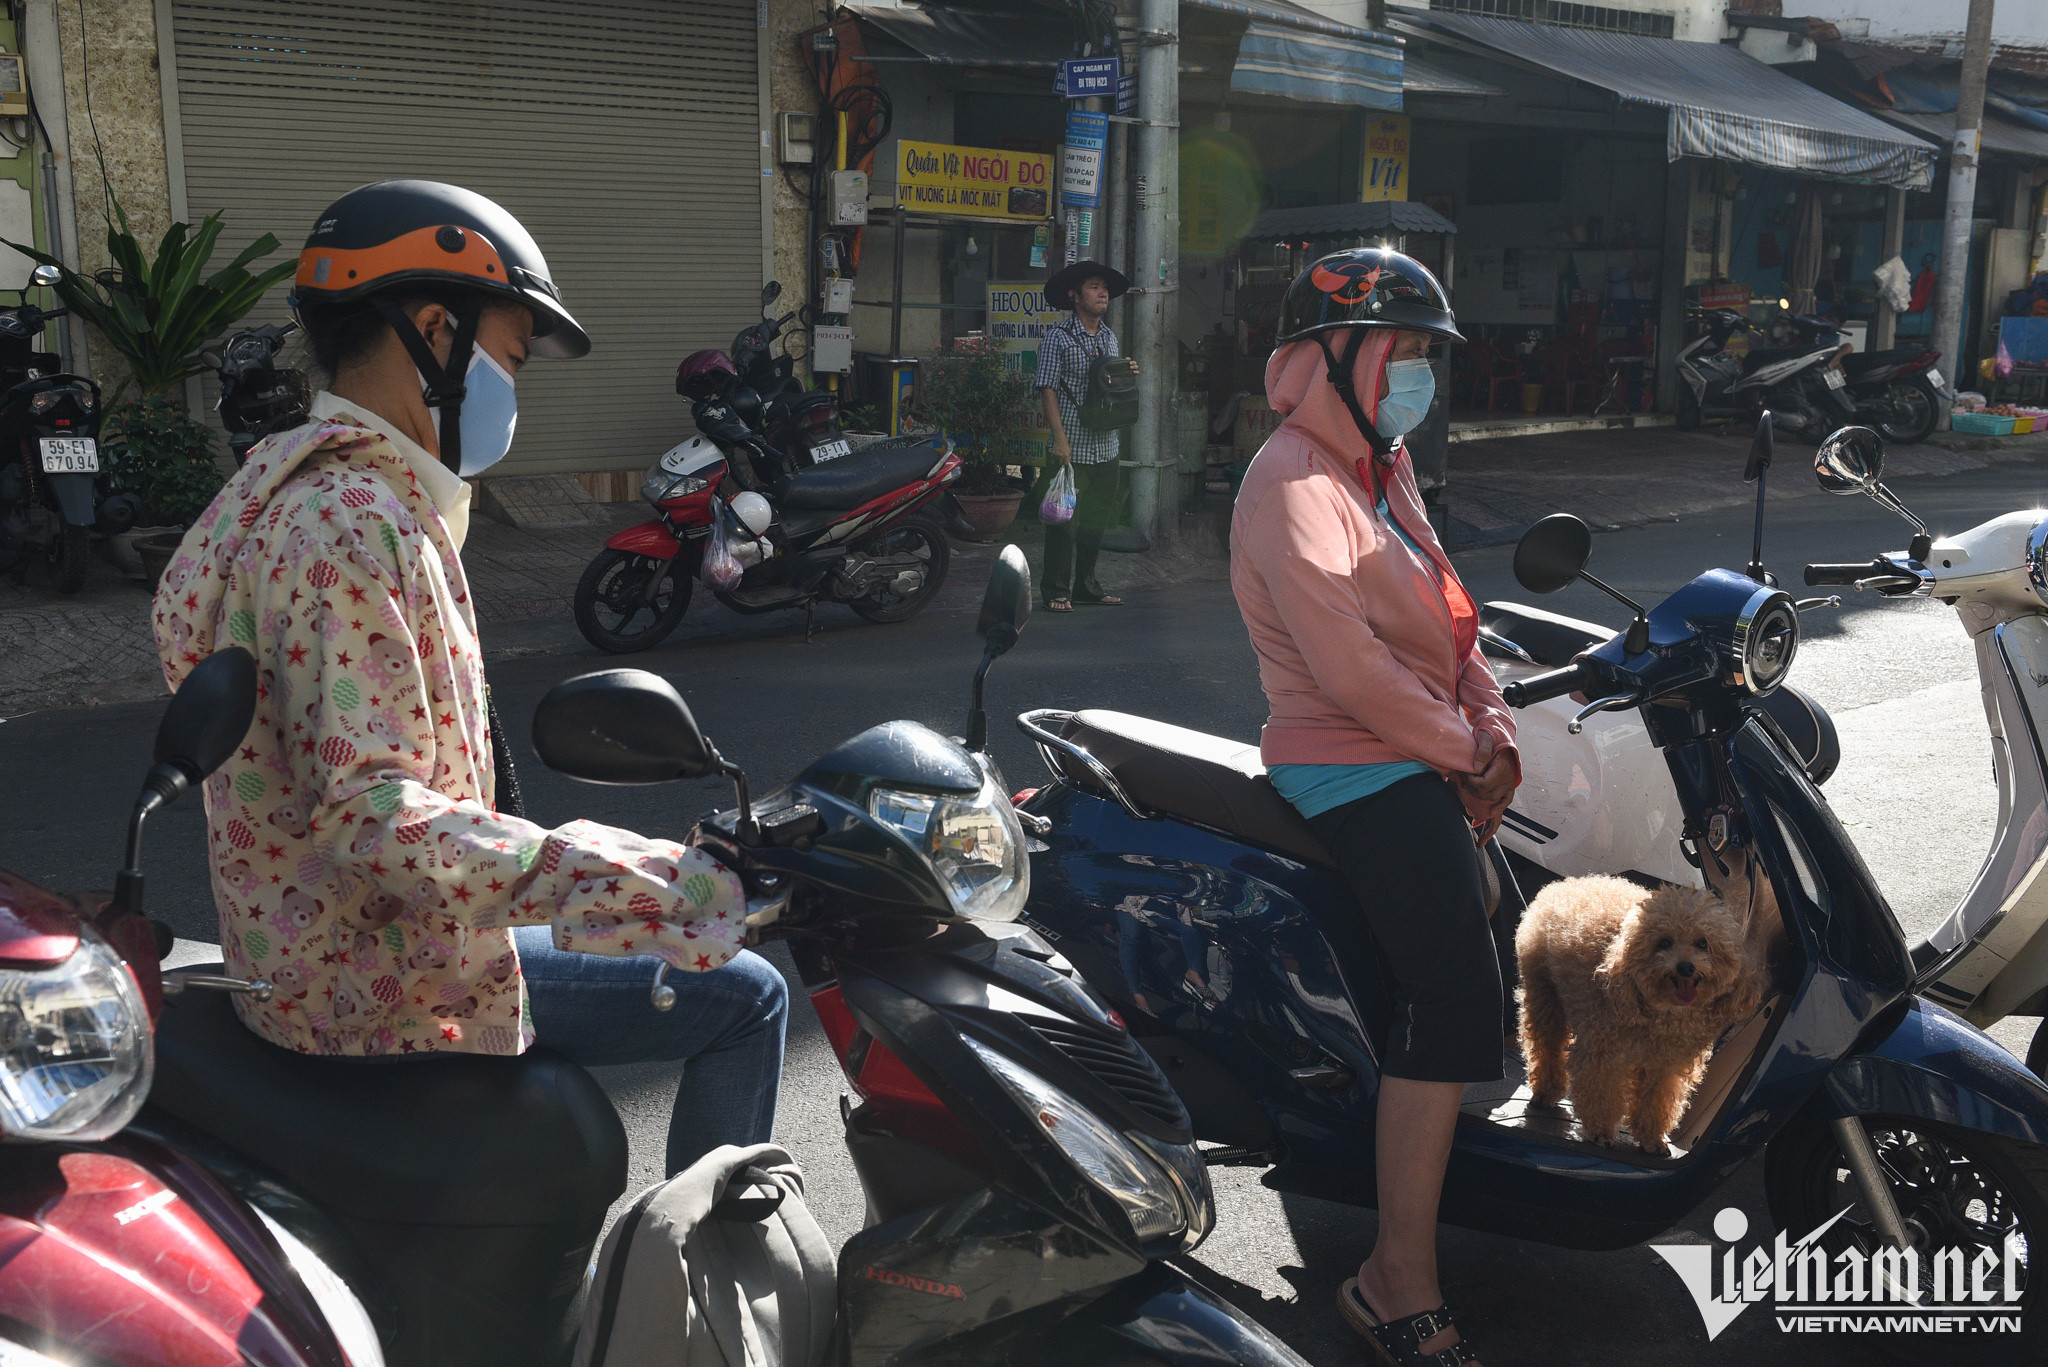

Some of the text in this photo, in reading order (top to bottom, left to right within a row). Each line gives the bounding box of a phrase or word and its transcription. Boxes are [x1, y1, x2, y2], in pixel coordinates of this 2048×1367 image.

[1097, 76, 1108, 87] H23
[906, 149, 939, 178] Quán
[963, 153, 1010, 184] NGÓI
[1081, 169, 1095, 177] CAO
[1370, 157, 1402, 197] Vịt
[991, 291, 1061, 317] HEO QU
[1017, 320, 1027, 339] LÁ
[48, 440, 87, 455] 59-E1
[815, 442, 844, 459] 29-T1
[46, 455, 95, 471] 670.94
[365, 510, 384, 522] Pin
[399, 683, 418, 699] Pin
[435, 778, 458, 794] Pin
[426, 848, 436, 869] Pin
[479, 859, 498, 873] Pin
[307, 933, 325, 949] Pin
[865, 1265, 964, 1300] HONDA
